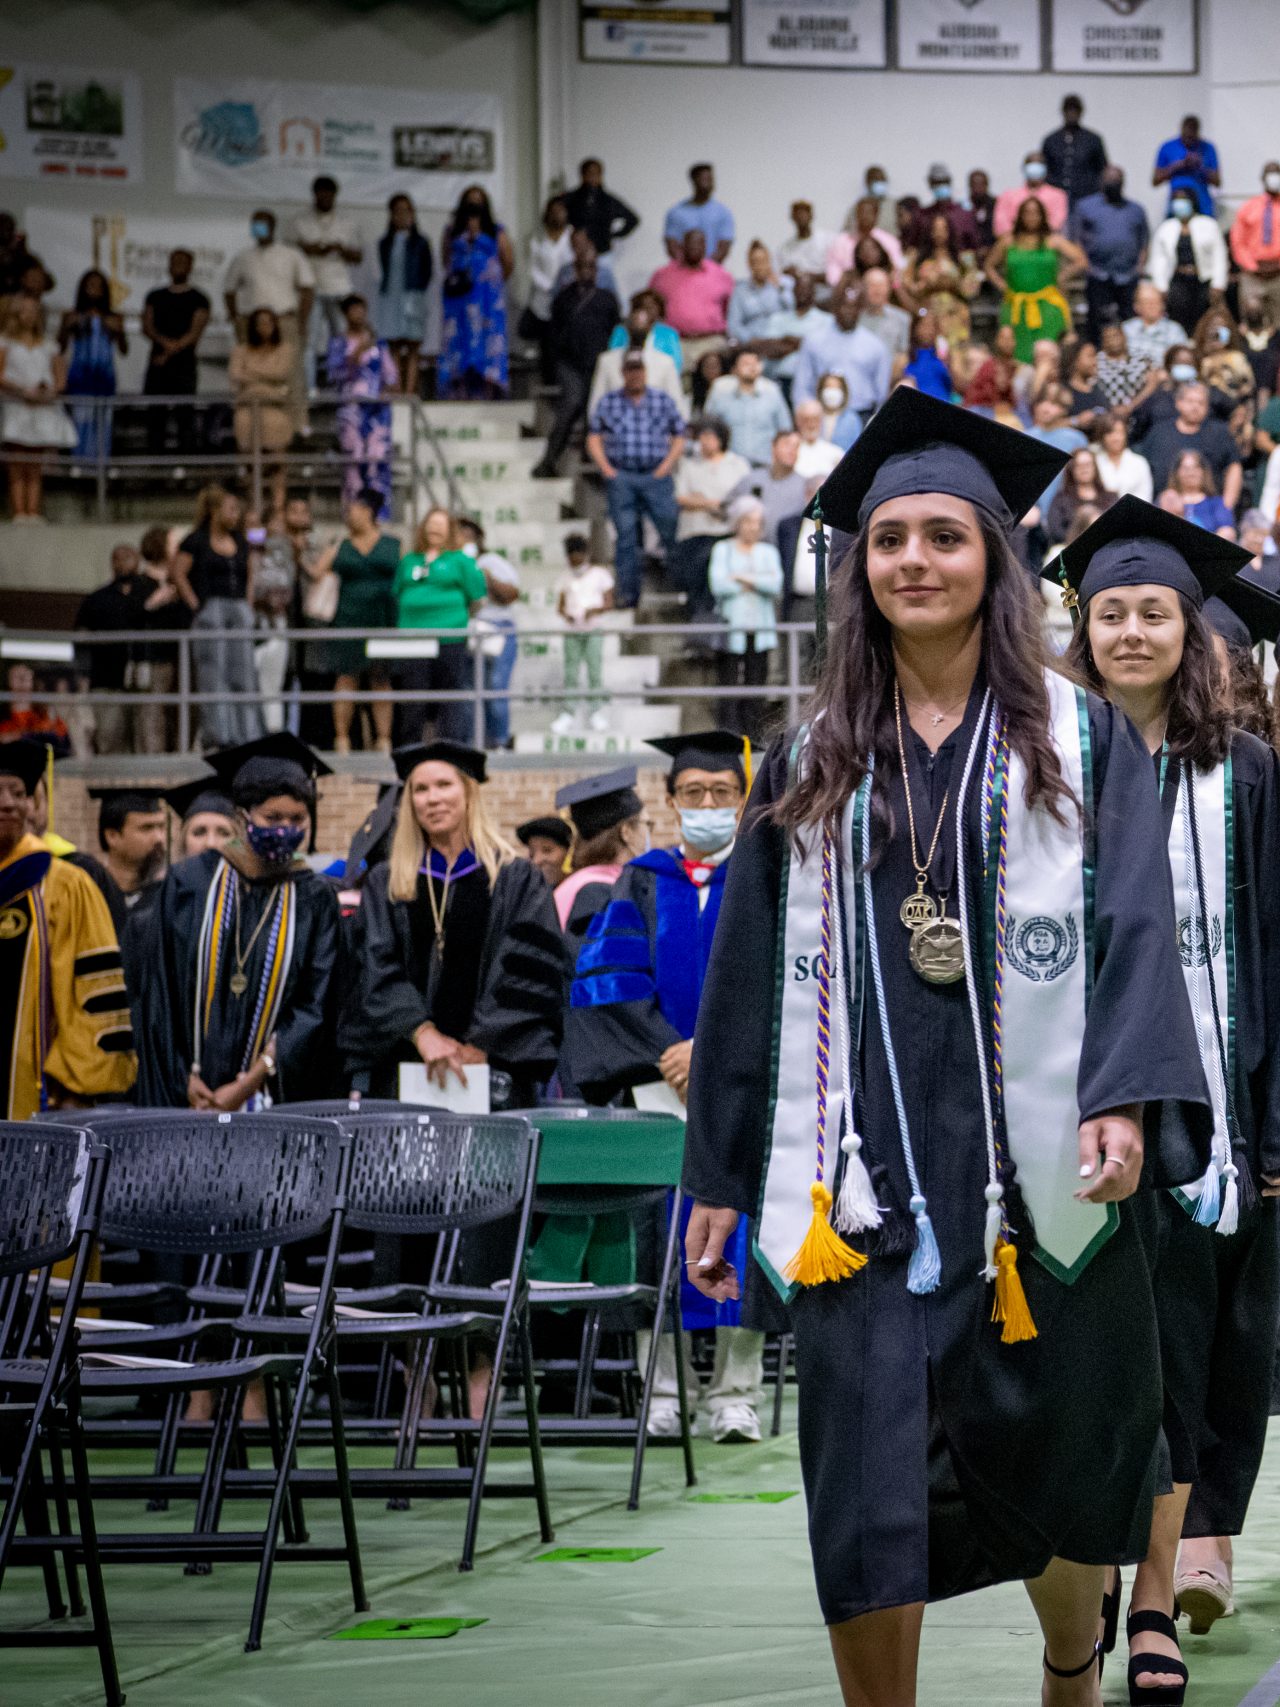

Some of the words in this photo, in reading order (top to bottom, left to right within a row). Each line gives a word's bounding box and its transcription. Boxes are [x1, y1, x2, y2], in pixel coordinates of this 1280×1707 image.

[777, 15, 850, 32] ALABAMA
[938, 23, 1000, 40] AUBURN
[767, 32, 859, 51] HUNTSVILLE
[1083, 25, 1165, 41] CHRISTIAN
[917, 42, 1020, 60] MONTGOMERY
[1083, 45, 1161, 61] BROTHERS
